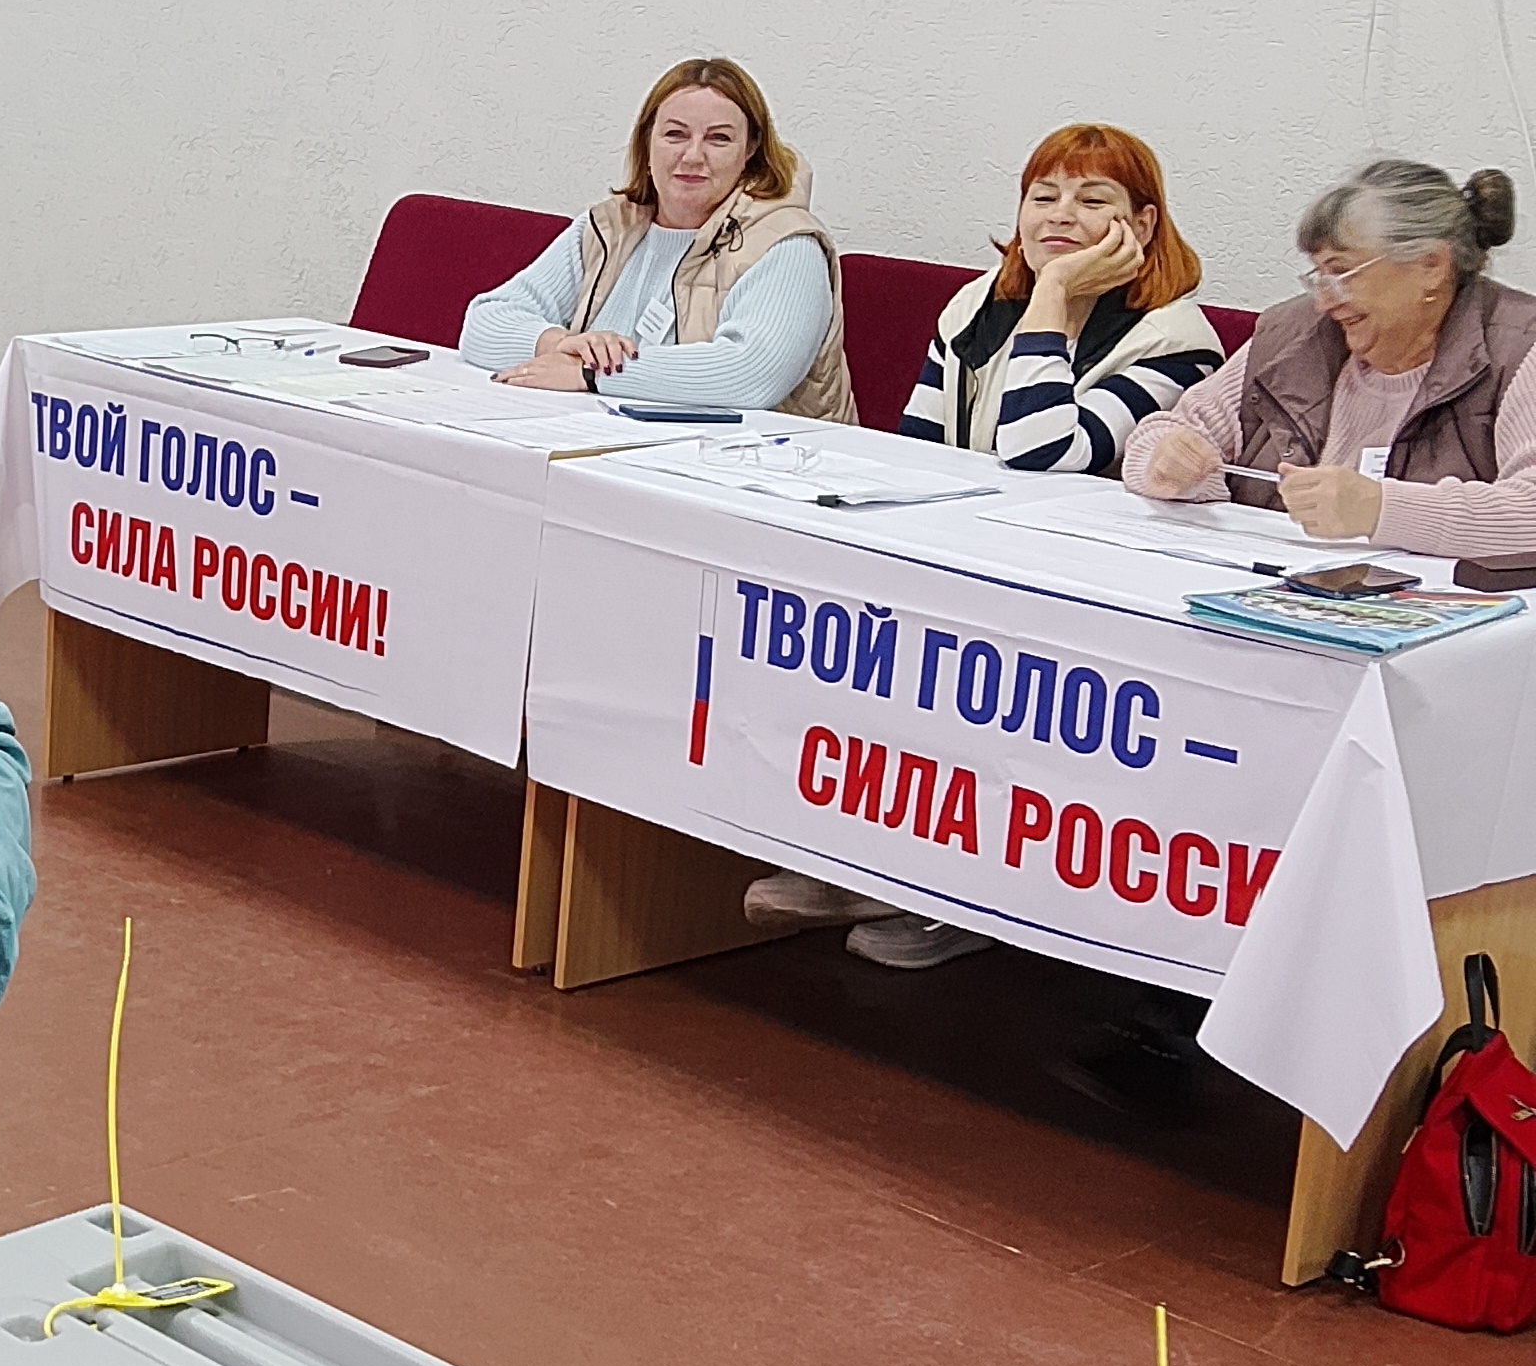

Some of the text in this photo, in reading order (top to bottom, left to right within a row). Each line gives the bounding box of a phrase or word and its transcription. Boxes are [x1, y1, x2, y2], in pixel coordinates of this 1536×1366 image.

[31, 392, 127, 476] ТВОЙ
[139, 419, 276, 516] ГОЛОС
[71, 502, 388, 657] СИЛА РОССИИ!
[736, 579, 898, 699] ТВОЙ
[917, 628, 1160, 769] ГОЛОС
[798, 726, 979, 855] СИЛА
